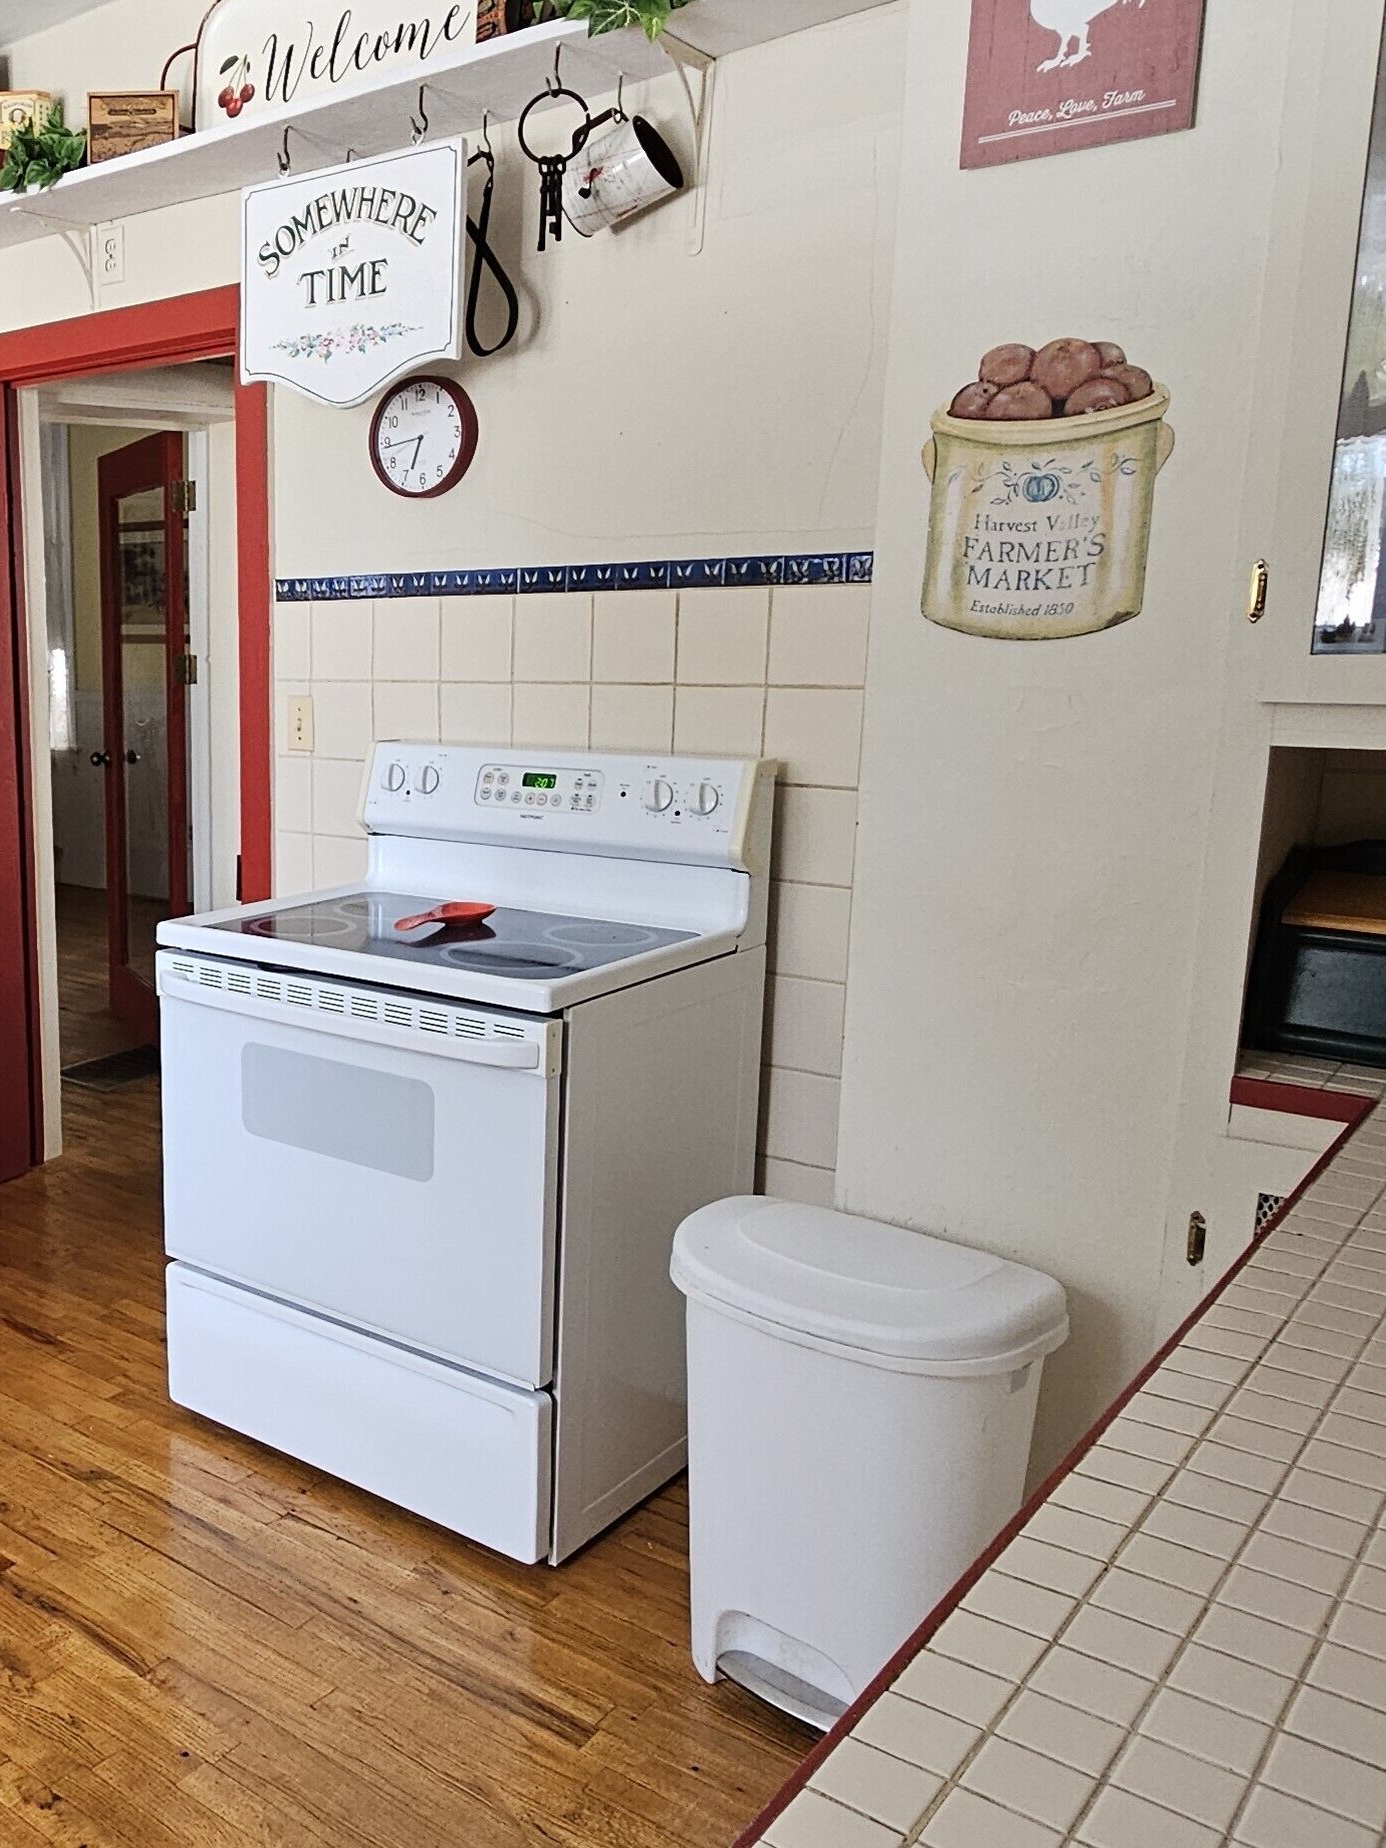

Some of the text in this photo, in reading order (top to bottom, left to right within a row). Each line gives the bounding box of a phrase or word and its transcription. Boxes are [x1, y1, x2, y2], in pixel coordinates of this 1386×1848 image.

[262, 4, 471, 103] Welcome
[1007, 89, 1146, 126] Peace, Love, Farm
[258, 186, 438, 277] SOMEWHERE
[330, 236, 351, 260] IN
[298, 258, 388, 305] TIME
[415, 388, 426, 402] 12
[401, 398, 408, 411] 11
[447, 404, 455, 418] 2
[388, 415, 399, 429] 10
[453, 425, 461, 438] 3
[384, 436, 392, 449] 9
[448, 448, 455, 459] 4
[390, 456, 397, 469] 8
[402, 469, 410, 481] 7
[436, 464, 443, 477] 5
[419, 472, 427, 485] 6
[974, 513, 1038, 533] Harvest
[963, 532, 1106, 563] FARMER'S
[967, 562, 1096, 591] MARKET
[970, 599, 1075, 616] Established 1850
